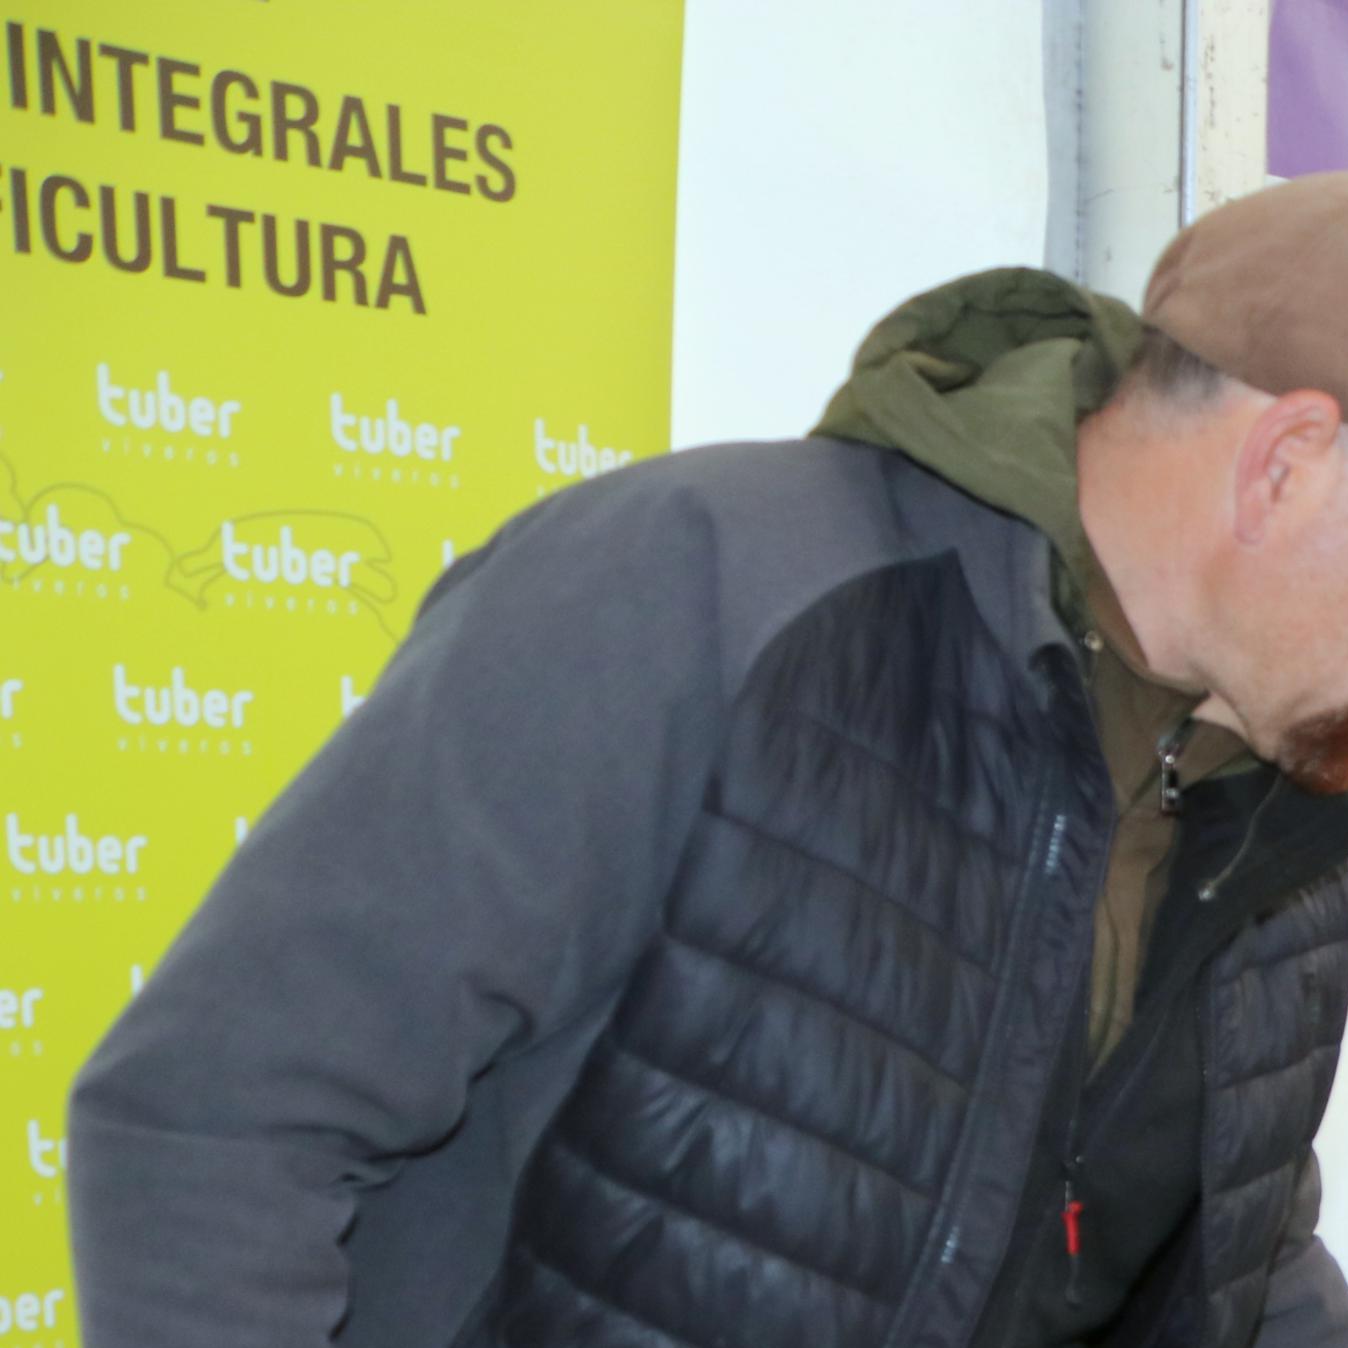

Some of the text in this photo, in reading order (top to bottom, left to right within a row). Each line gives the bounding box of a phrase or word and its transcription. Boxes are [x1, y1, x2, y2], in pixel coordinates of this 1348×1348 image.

[6, 19, 517, 203] INTEGRALES
[0, 164, 427, 316] ICULTURA
[97, 362, 243, 440] tuber
[330, 391, 463, 462] tuber
[221, 520, 361, 588] tuber
[112, 662, 256, 729] tuber
[5, 811, 148, 875] tuber
